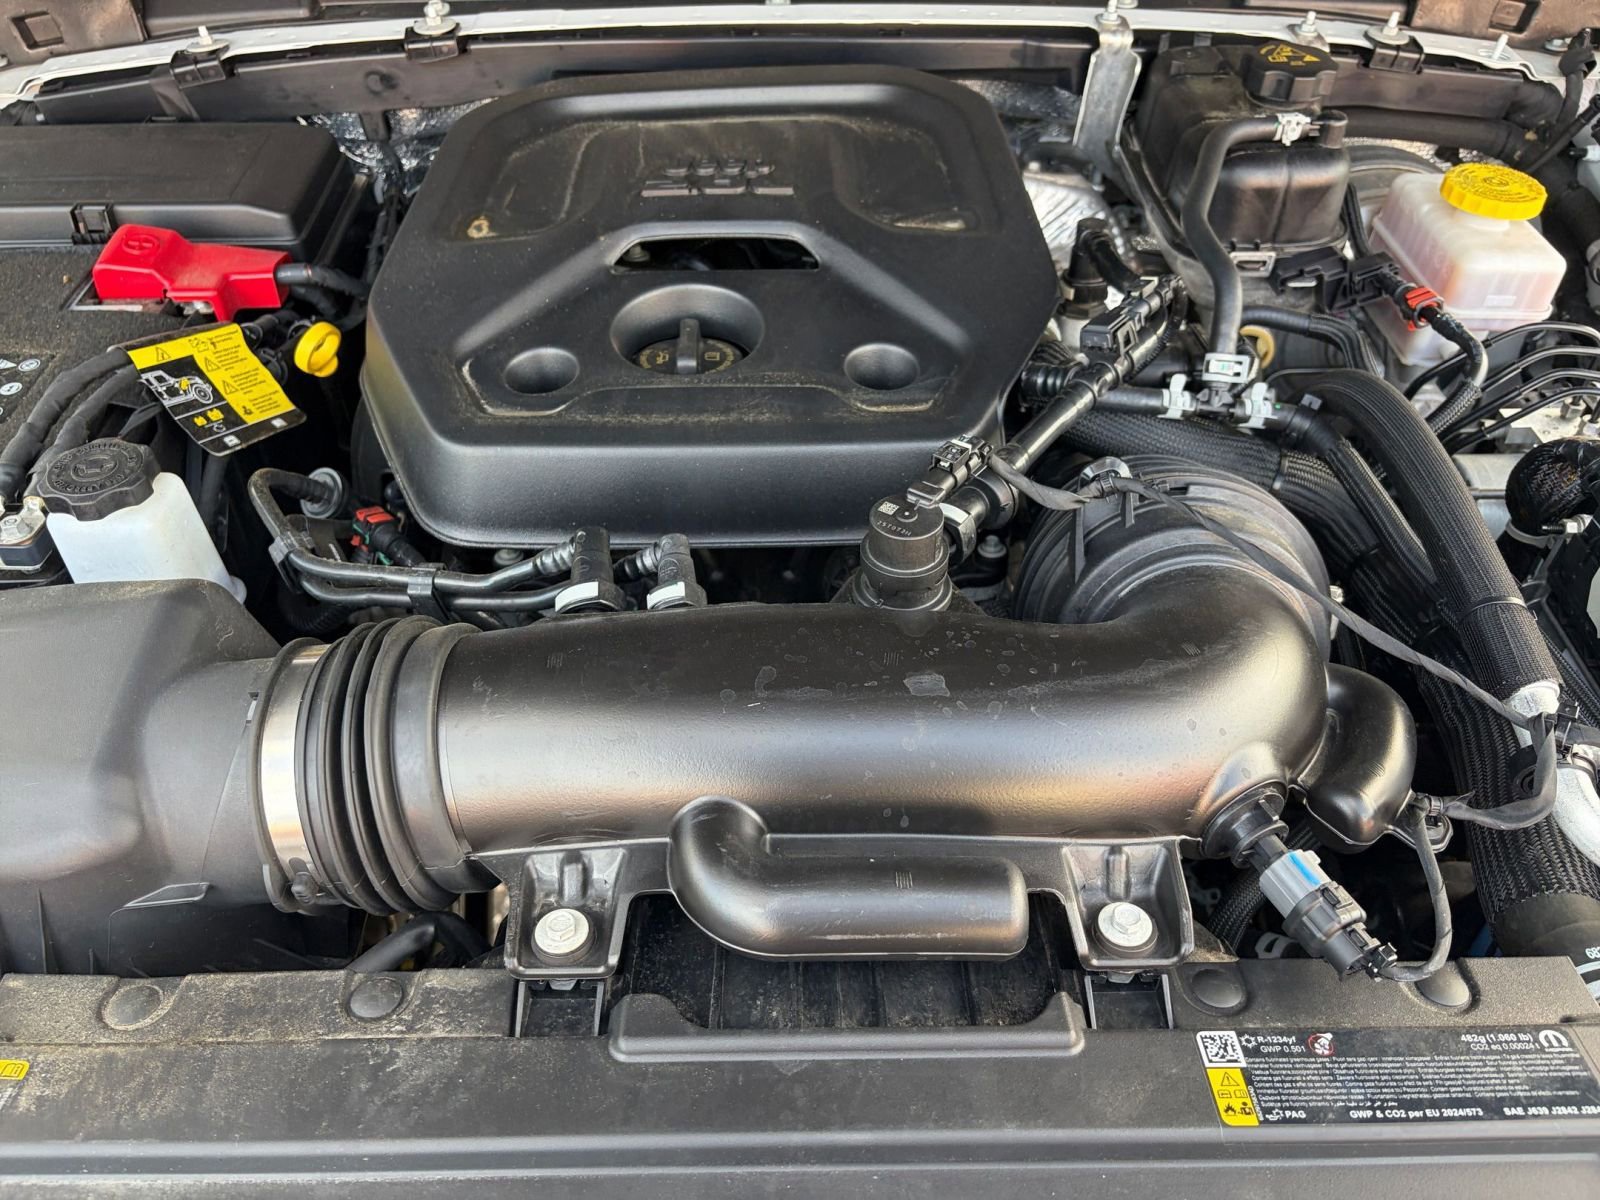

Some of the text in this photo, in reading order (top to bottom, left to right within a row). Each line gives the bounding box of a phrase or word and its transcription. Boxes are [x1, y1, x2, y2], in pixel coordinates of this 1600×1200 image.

[1257, 1035, 1297, 1045] R-1234yf
[1461, 1034, 1486, 1043] 482g
[1519, 1032, 1533, 1042] lb)
[1260, 1045, 1306, 1053] GWP 0.501
[1471, 1043, 1490, 1051] CO2
[1492, 1044, 1502, 1052] eq
[1285, 1110, 1306, 1119] PAG
[1349, 1107, 1483, 1119] GWP & CO2 per EU 2024/573
[1503, 1107, 1526, 1116] SAE
[1527, 1107, 1549, 1116] J639
[1551, 1106, 1580, 1115] J2842
